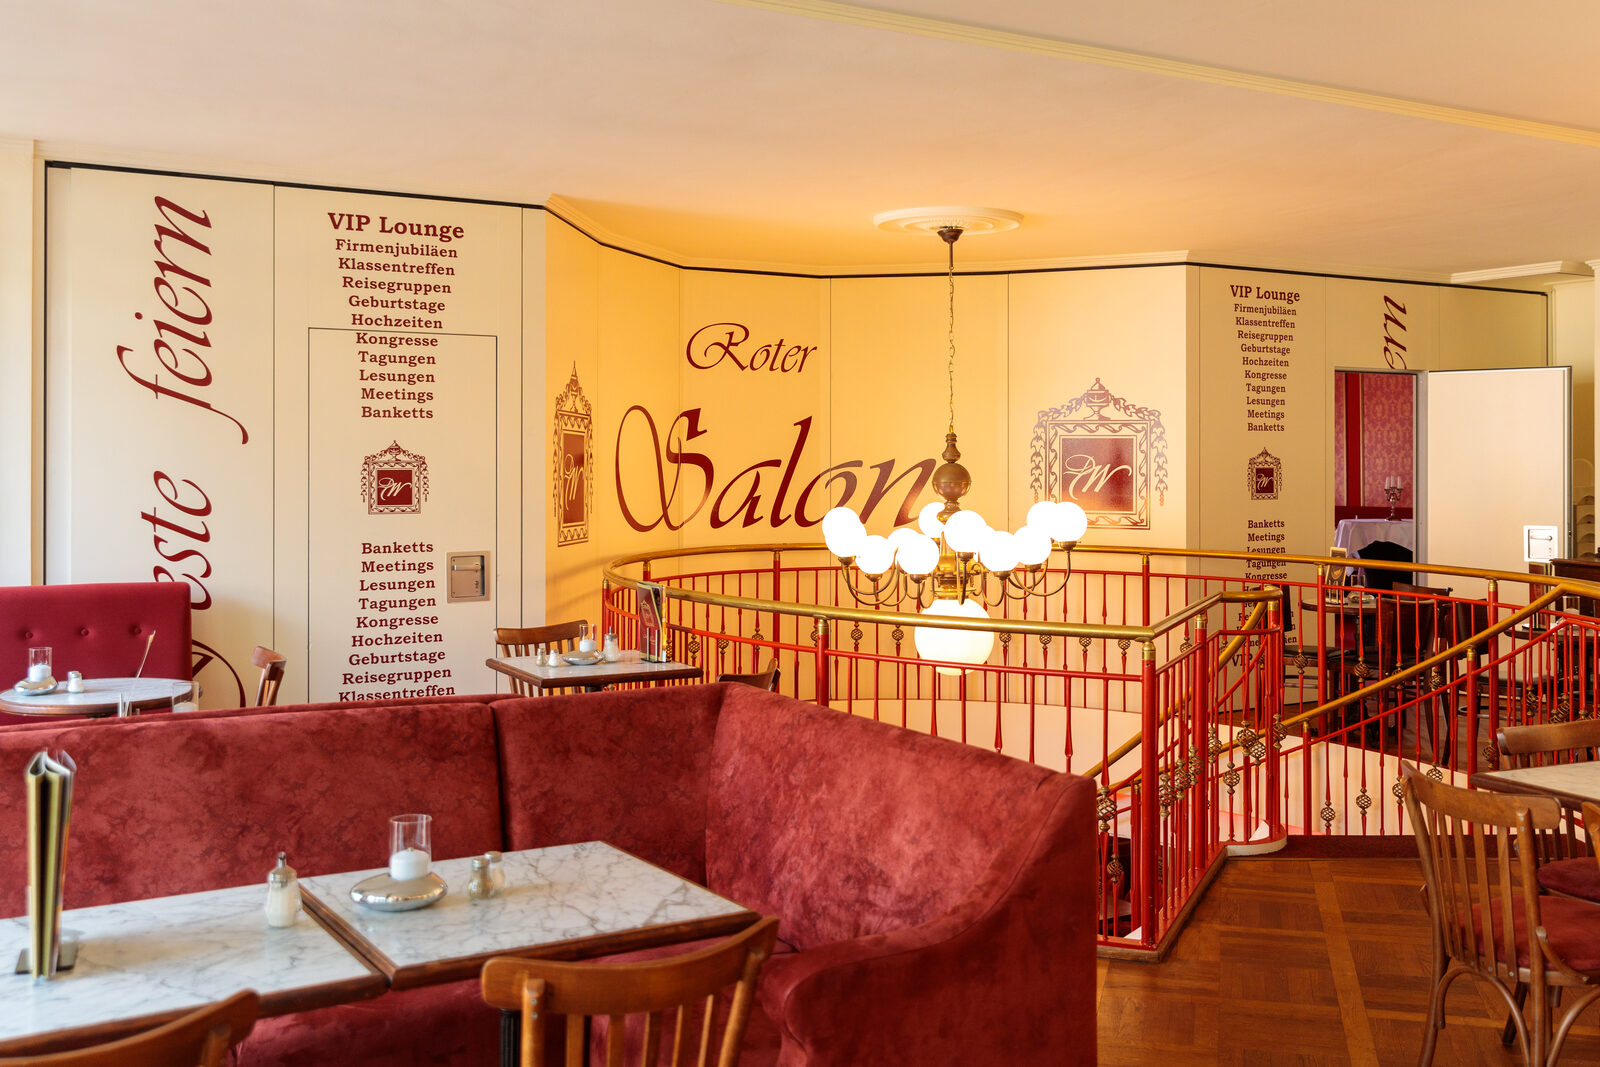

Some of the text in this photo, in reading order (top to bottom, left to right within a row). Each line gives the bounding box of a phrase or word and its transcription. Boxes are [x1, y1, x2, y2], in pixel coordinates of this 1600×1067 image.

[327, 212, 465, 243] VIP Lounge
[335, 238, 458, 259] Firmenjubiläen
[338, 257, 456, 276] Klassentreffen
[342, 275, 452, 296] Reisegruppen
[1229, 284, 1300, 305] VIP Lounge
[348, 294, 446, 314] Geburtstage
[1234, 303, 1297, 317] Firmenjubiläen
[116, 195, 249, 445] feiern
[351, 313, 443, 329] Hochzeiten
[1235, 316, 1296, 329] Klassentreffen
[355, 332, 439, 349] Kongresse
[1237, 329, 1294, 344] Reisegruppen
[686, 322, 818, 373] Roter
[1240, 343, 1291, 357] Geburtstage
[357, 350, 437, 368] Tagungen
[1242, 356, 1289, 367] Hochzeiten
[359, 369, 436, 386] Lesungen
[1244, 369, 1288, 382] Kongresse
[361, 387, 434, 404] Meetings
[1245, 382, 1286, 395] Tagungen
[1246, 396, 1286, 408] Lesungen
[361, 406, 434, 419] Banketts
[1247, 409, 1285, 421] Meetings
[1247, 422, 1285, 432] Banketts
[615, 404, 937, 533] Salon
[1247, 519, 1285, 529] Banketts
[1247, 532, 1286, 544] Meetings
[361, 541, 434, 555] Banketts
[361, 559, 434, 575] Meetings
[1244, 572, 1288, 581] Kongresse
[359, 579, 436, 593] Lesungen
[358, 597, 437, 613] Tagungen
[356, 615, 439, 630] Kongresse
[351, 631, 444, 648] Hochzeiten
[348, 650, 446, 666] Geburtstage
[342, 668, 452, 686] Reisegruppen
[338, 684, 456, 702] Klassentreffen
